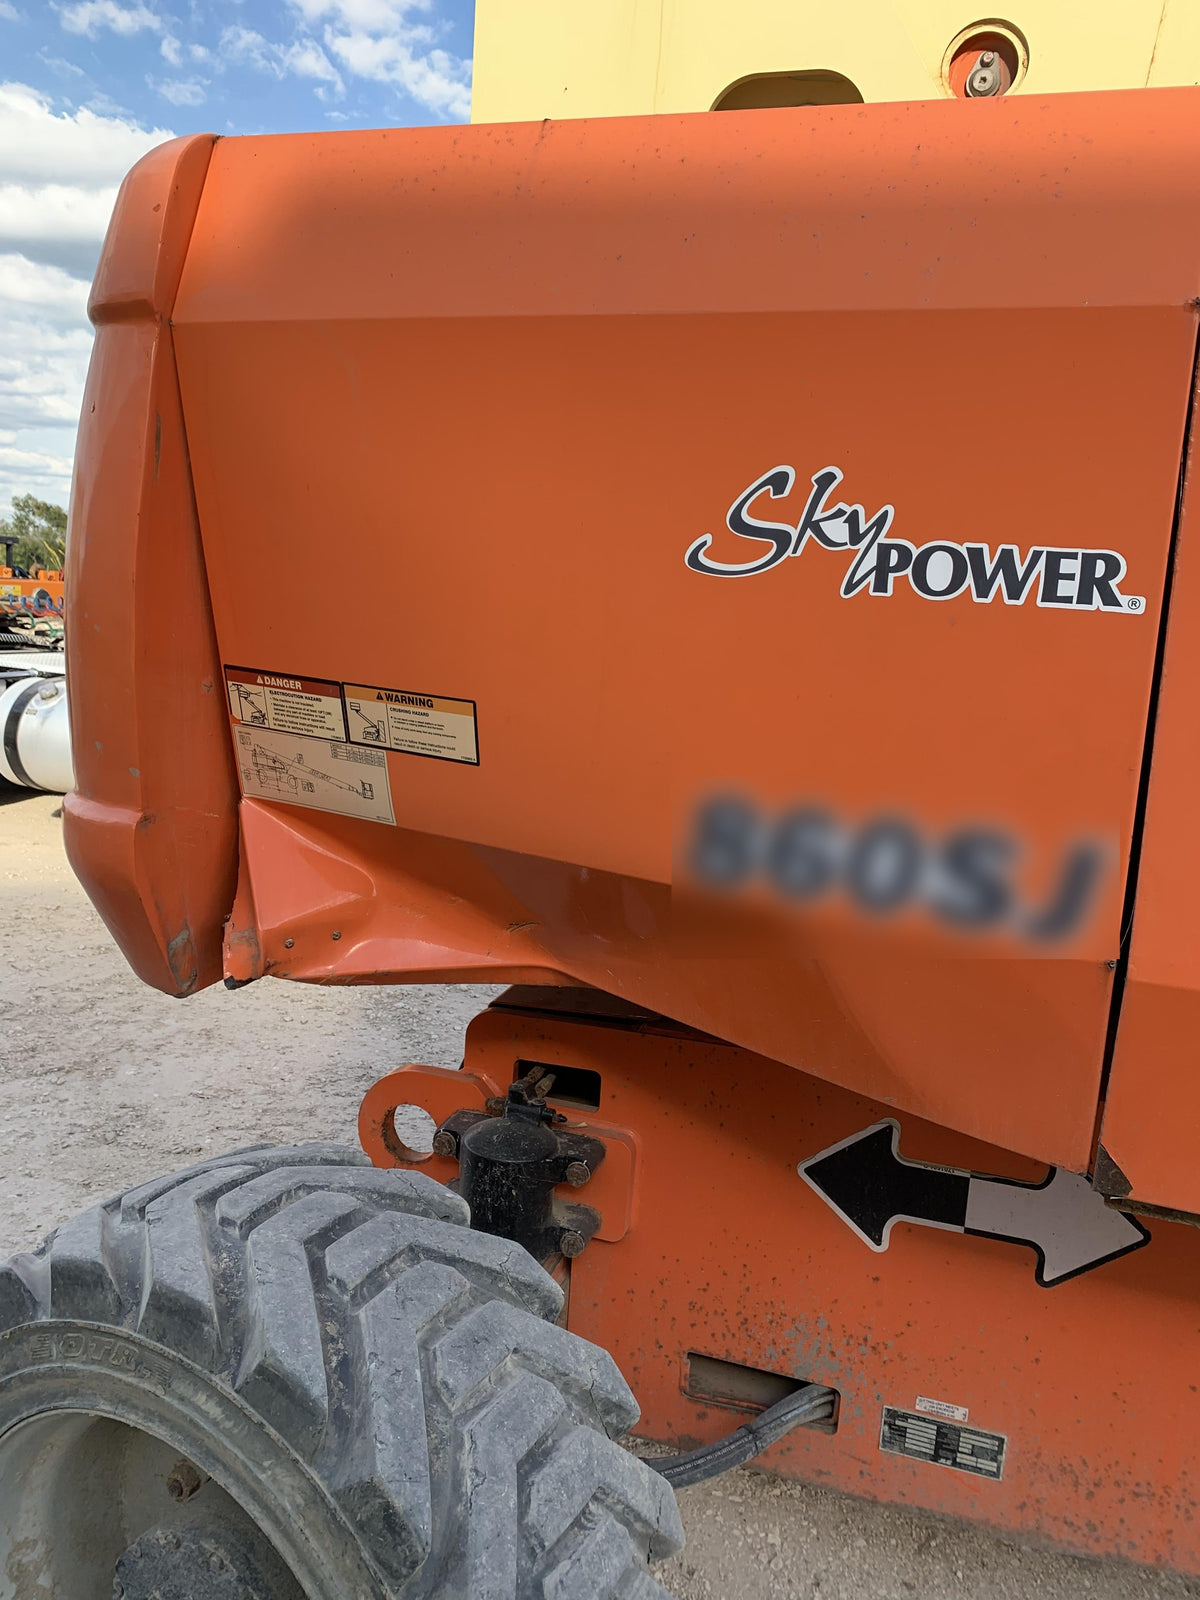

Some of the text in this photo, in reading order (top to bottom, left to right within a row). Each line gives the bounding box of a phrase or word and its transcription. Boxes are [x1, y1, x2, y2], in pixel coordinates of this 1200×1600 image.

[686, 466, 894, 598] Sky
[264, 676, 303, 691] DANGER
[269, 690, 304, 699] ELECTROCUTION
[384, 692, 434, 709] WARNING
[389, 706, 430, 718] CRUSHING HAZARD
